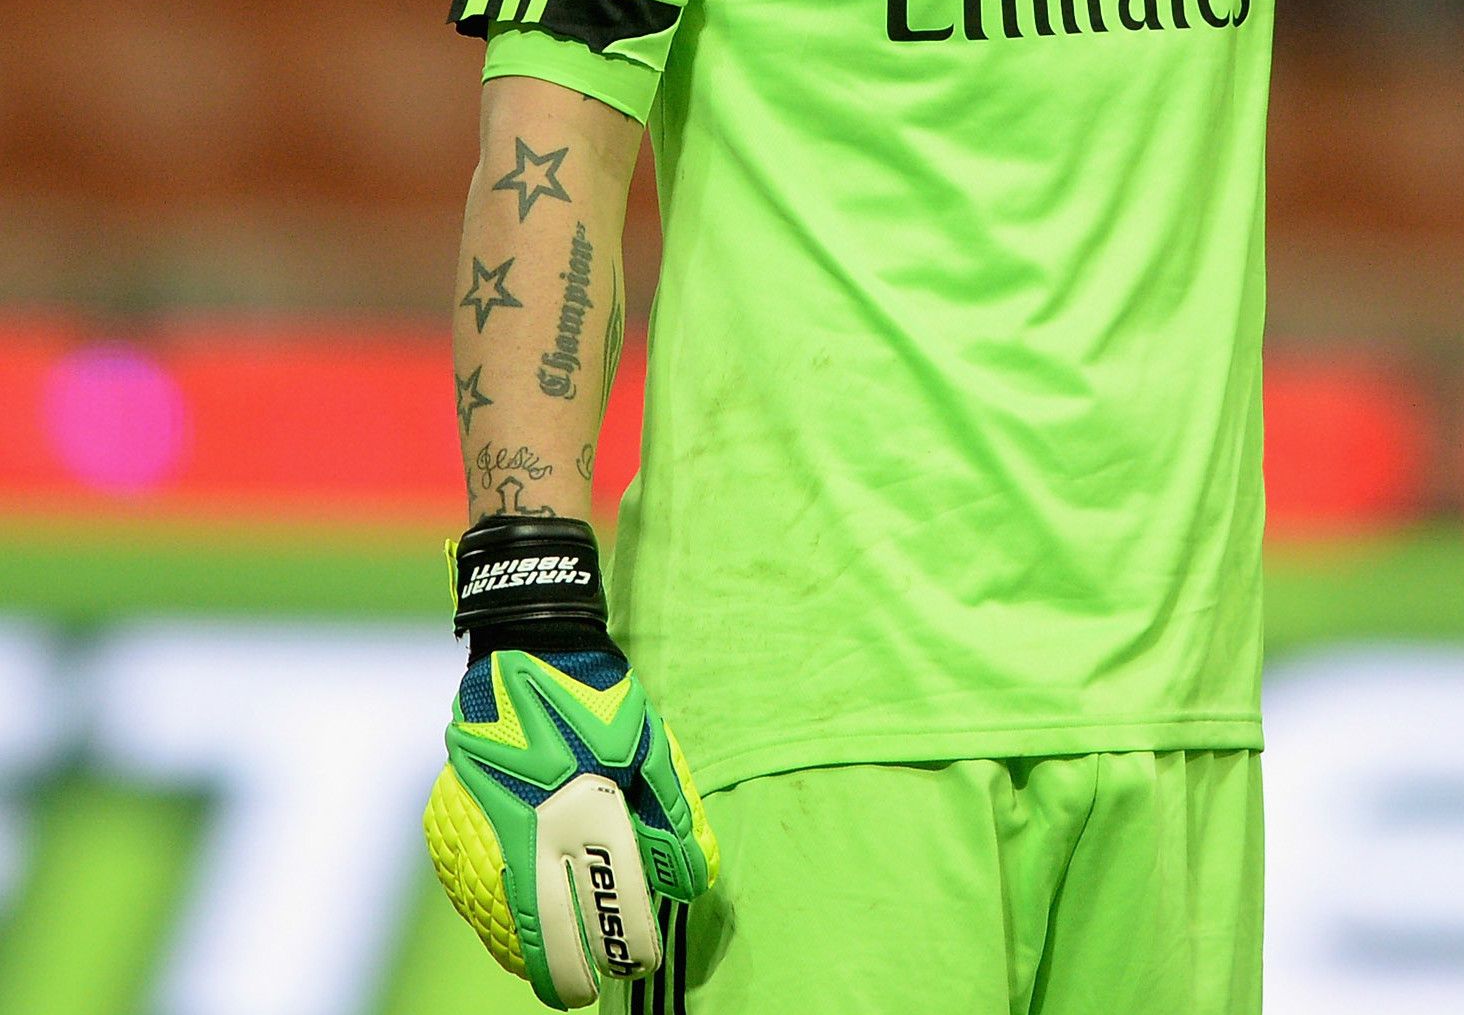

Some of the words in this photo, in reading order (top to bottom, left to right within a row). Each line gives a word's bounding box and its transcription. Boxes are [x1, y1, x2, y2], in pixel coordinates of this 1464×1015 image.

[470, 556, 580, 581] ABBIATI
[461, 569, 591, 600] CHRISTIAN
[585, 846, 642, 976] reusch
